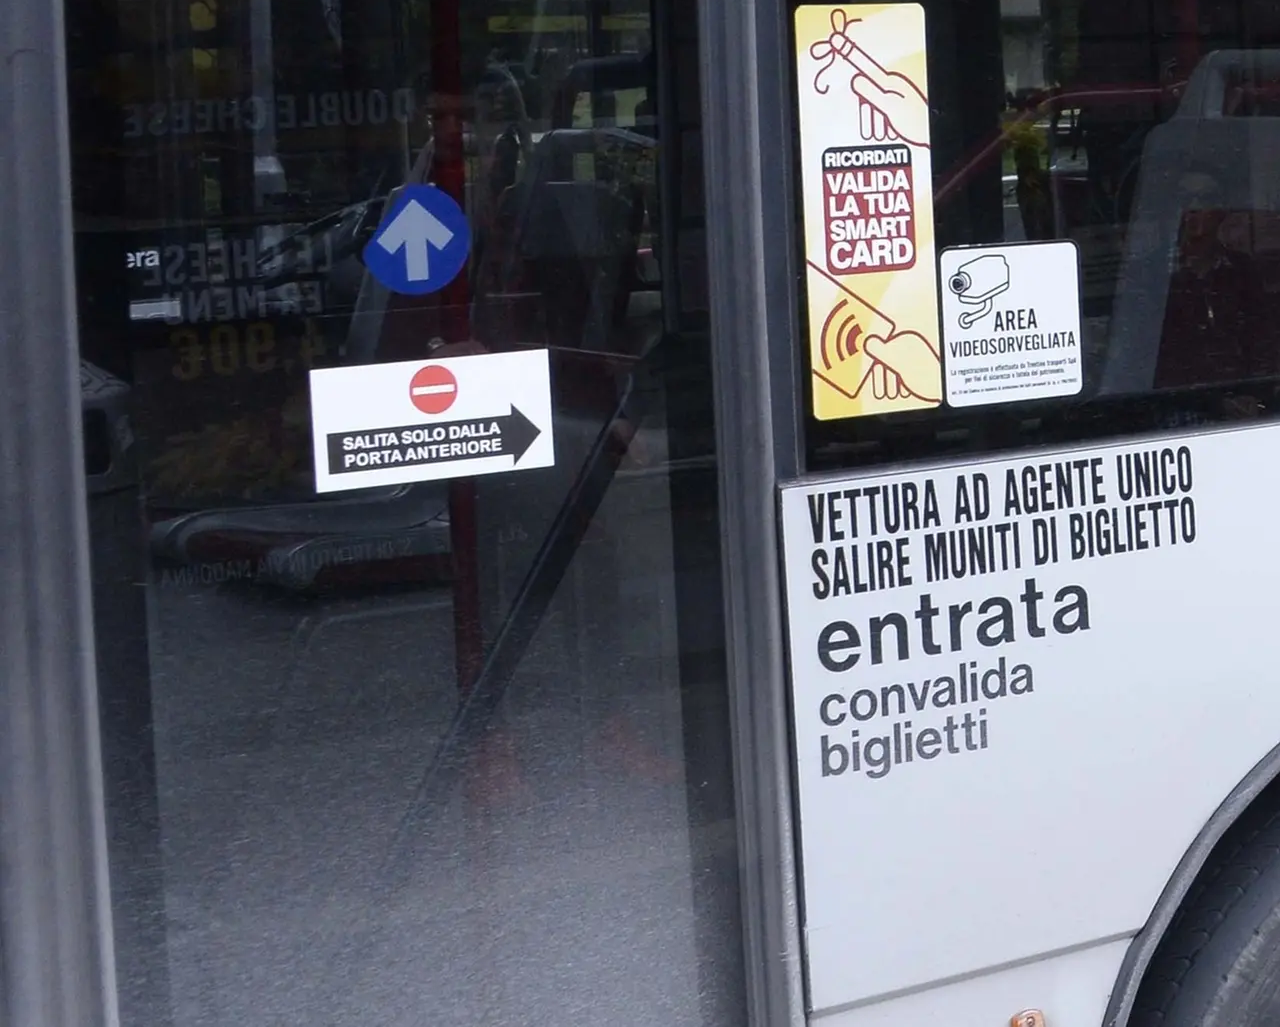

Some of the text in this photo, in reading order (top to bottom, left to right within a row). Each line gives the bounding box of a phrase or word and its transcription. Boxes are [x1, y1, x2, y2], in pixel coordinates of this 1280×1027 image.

[824, 148, 909, 168] RICORDATI
[826, 170, 910, 195] VALIDA
[829, 191, 911, 218] LA TUA
[829, 215, 911, 241] SMART
[829, 240, 914, 270] CARD
[993, 307, 1038, 332] AREA
[949, 331, 1077, 358] VIDEOSORVEGLIATA
[342, 422, 501, 451] SALITA SOLO DALLA
[344, 438, 502, 468] PORTA ANTERIORE
[807, 445, 1193, 544] VETTURA AD AGENTE UNICO
[811, 496, 1197, 601] SALIRE MUNITI DI BIGLIETTO
[816, 578, 1091, 673] entrata
[819, 656, 1035, 727] convalida
[820, 708, 989, 780] biglietti
